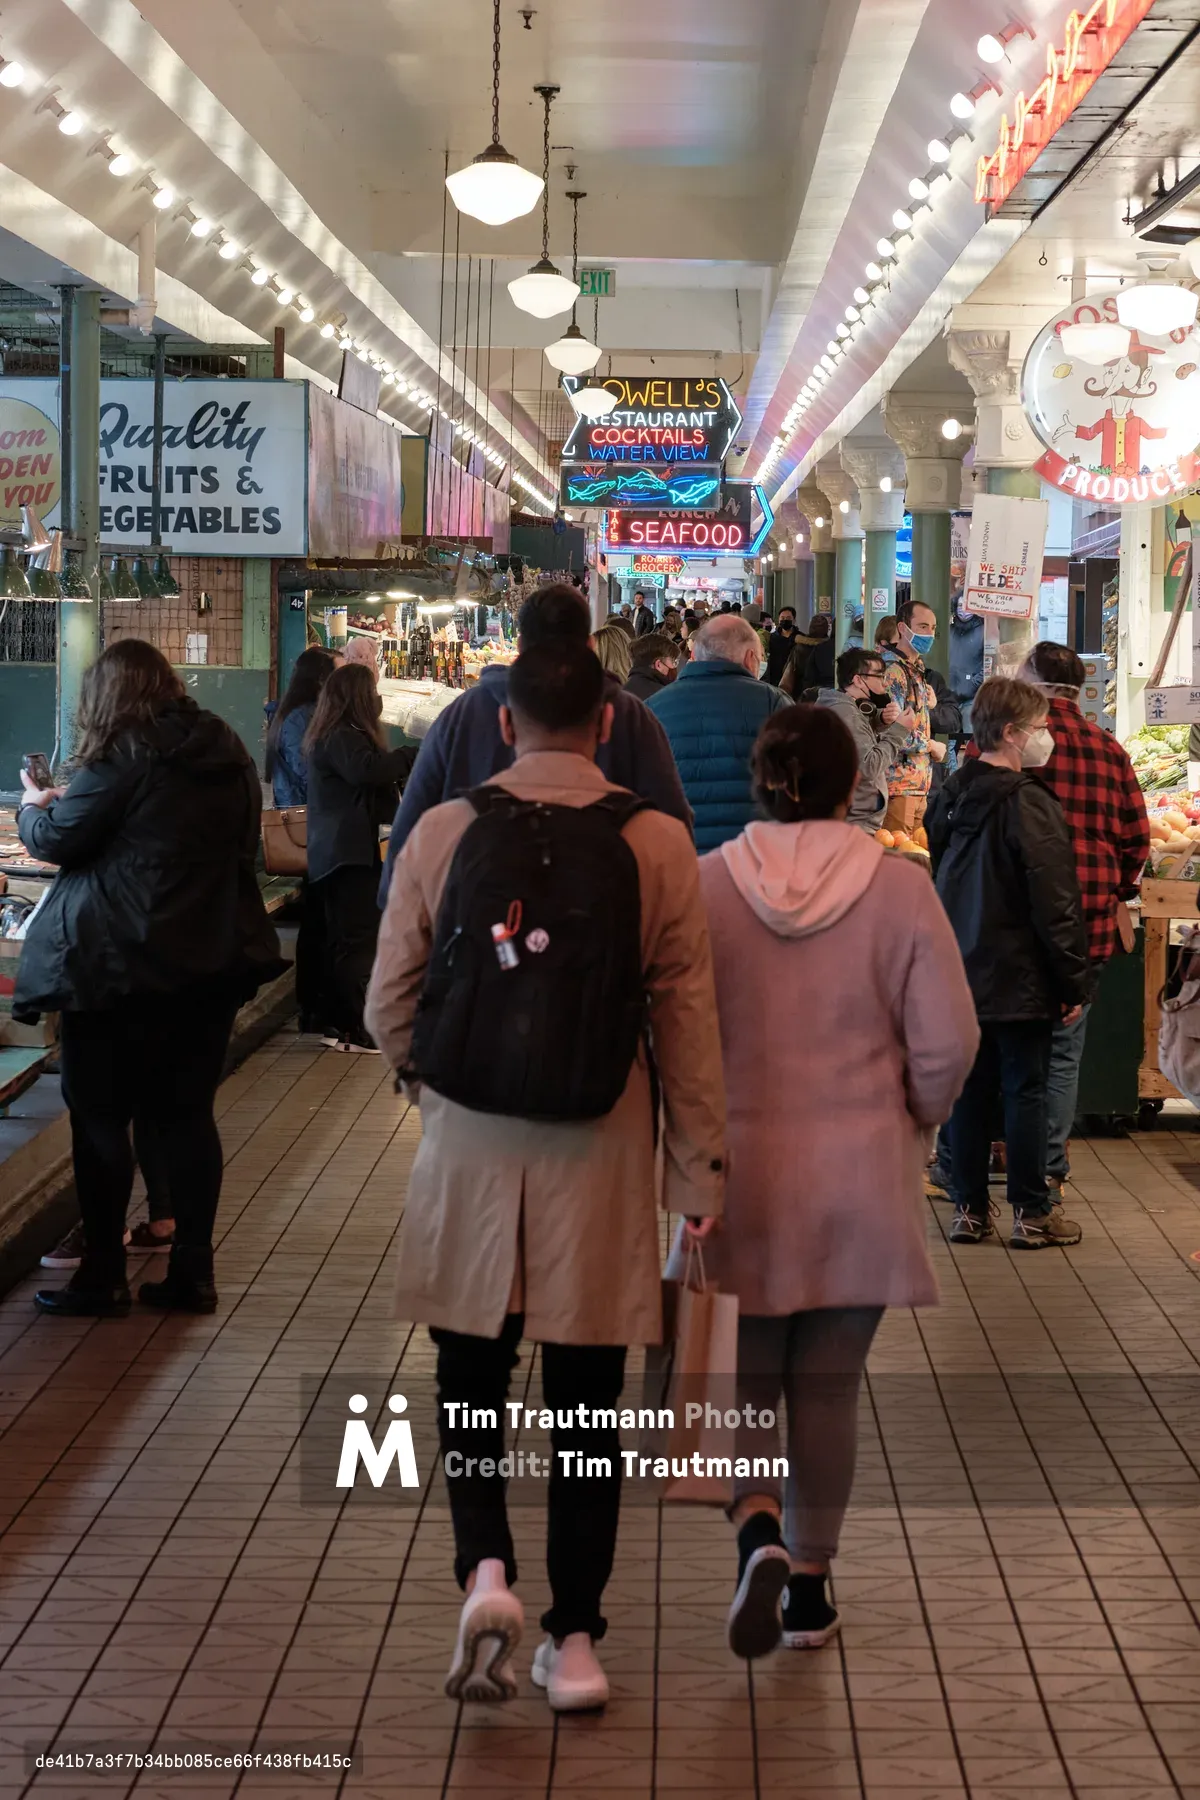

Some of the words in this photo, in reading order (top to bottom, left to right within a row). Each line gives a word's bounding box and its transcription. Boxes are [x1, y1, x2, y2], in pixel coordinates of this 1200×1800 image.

[581, 271, 610, 294] EXIT
[588, 379, 721, 408] OWELL'S
[0, 429, 47, 450] om
[99, 401, 267, 463] Quality
[591, 428, 705, 444] COCKTAILS
[590, 445, 655, 461] WATER
[661, 445, 710, 461] VIEW
[0, 453, 54, 480] DEN
[236, 465, 264, 495] &
[1057, 463, 1187, 502] PRODUCE
[4, 482, 55, 509] YOU
[99, 505, 282, 535] EGETABLES
[610, 509, 620, 542] TAILS
[630, 521, 742, 547] SEAFOOD
[951, 547, 969, 559] OURS
[634, 563, 681, 573] GROCERY
[980, 563, 995, 573] WE
[1001, 564, 1027, 576] SHIP
